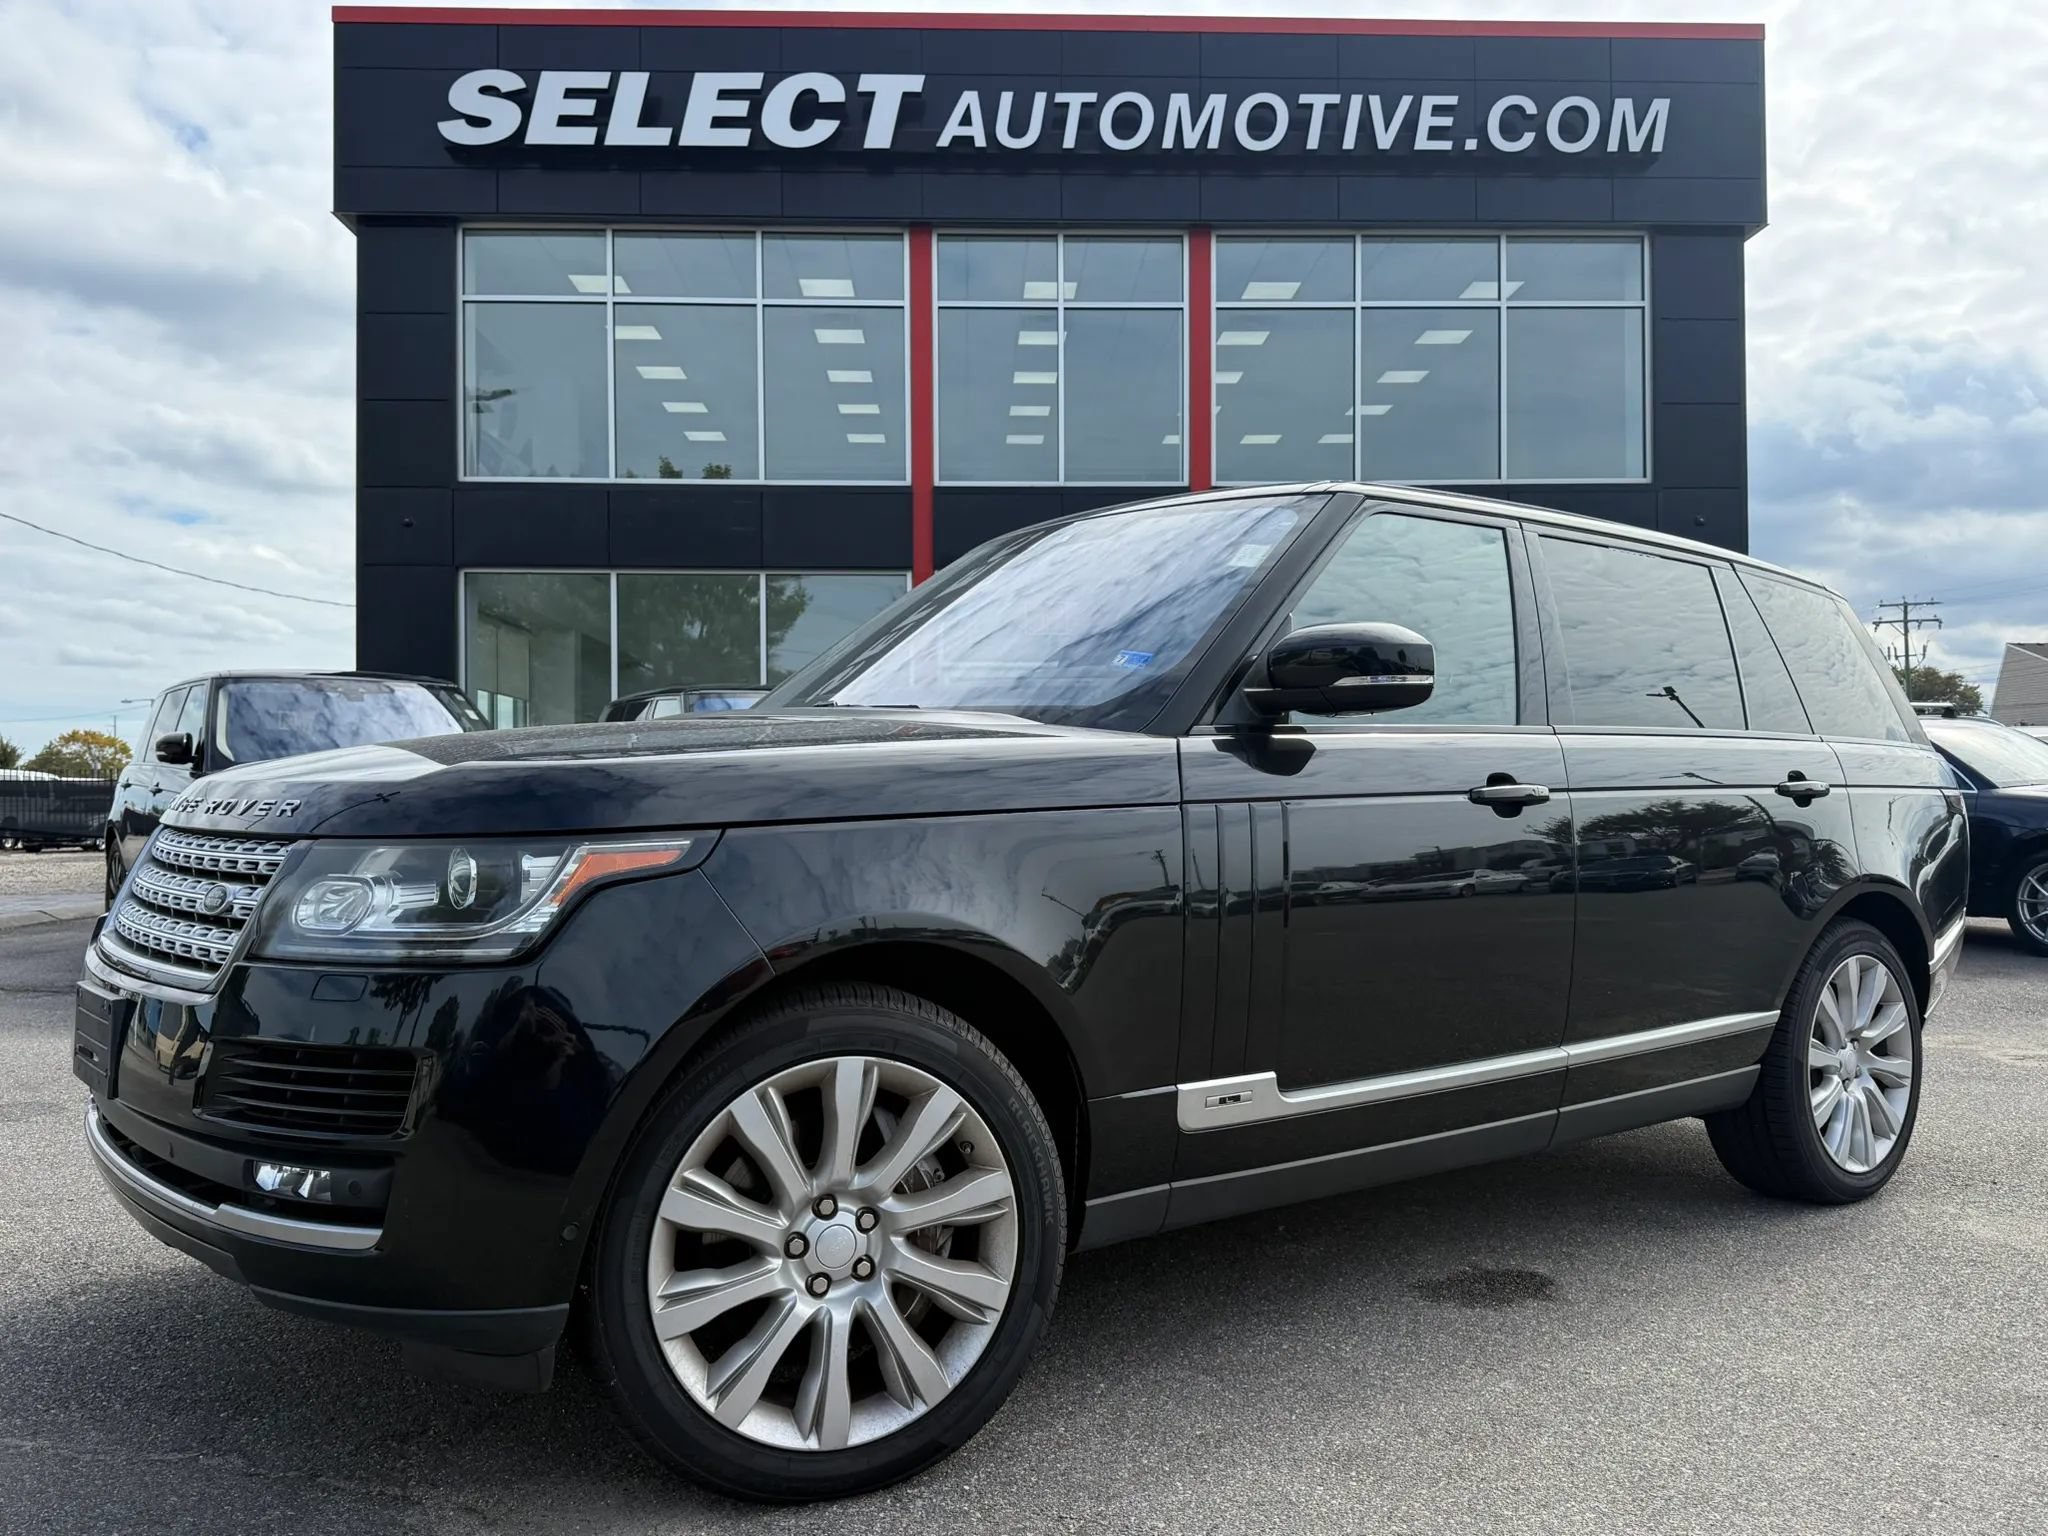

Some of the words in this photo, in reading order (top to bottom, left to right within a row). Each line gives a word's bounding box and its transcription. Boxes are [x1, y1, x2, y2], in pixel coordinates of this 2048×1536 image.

[437, 69, 926, 150] SELECT
[936, 91, 1671, 153] AUTOMOTIVE.COM
[204, 799, 302, 817] ROVER
[1009, 1097, 1055, 1227] BLACKHAWK
